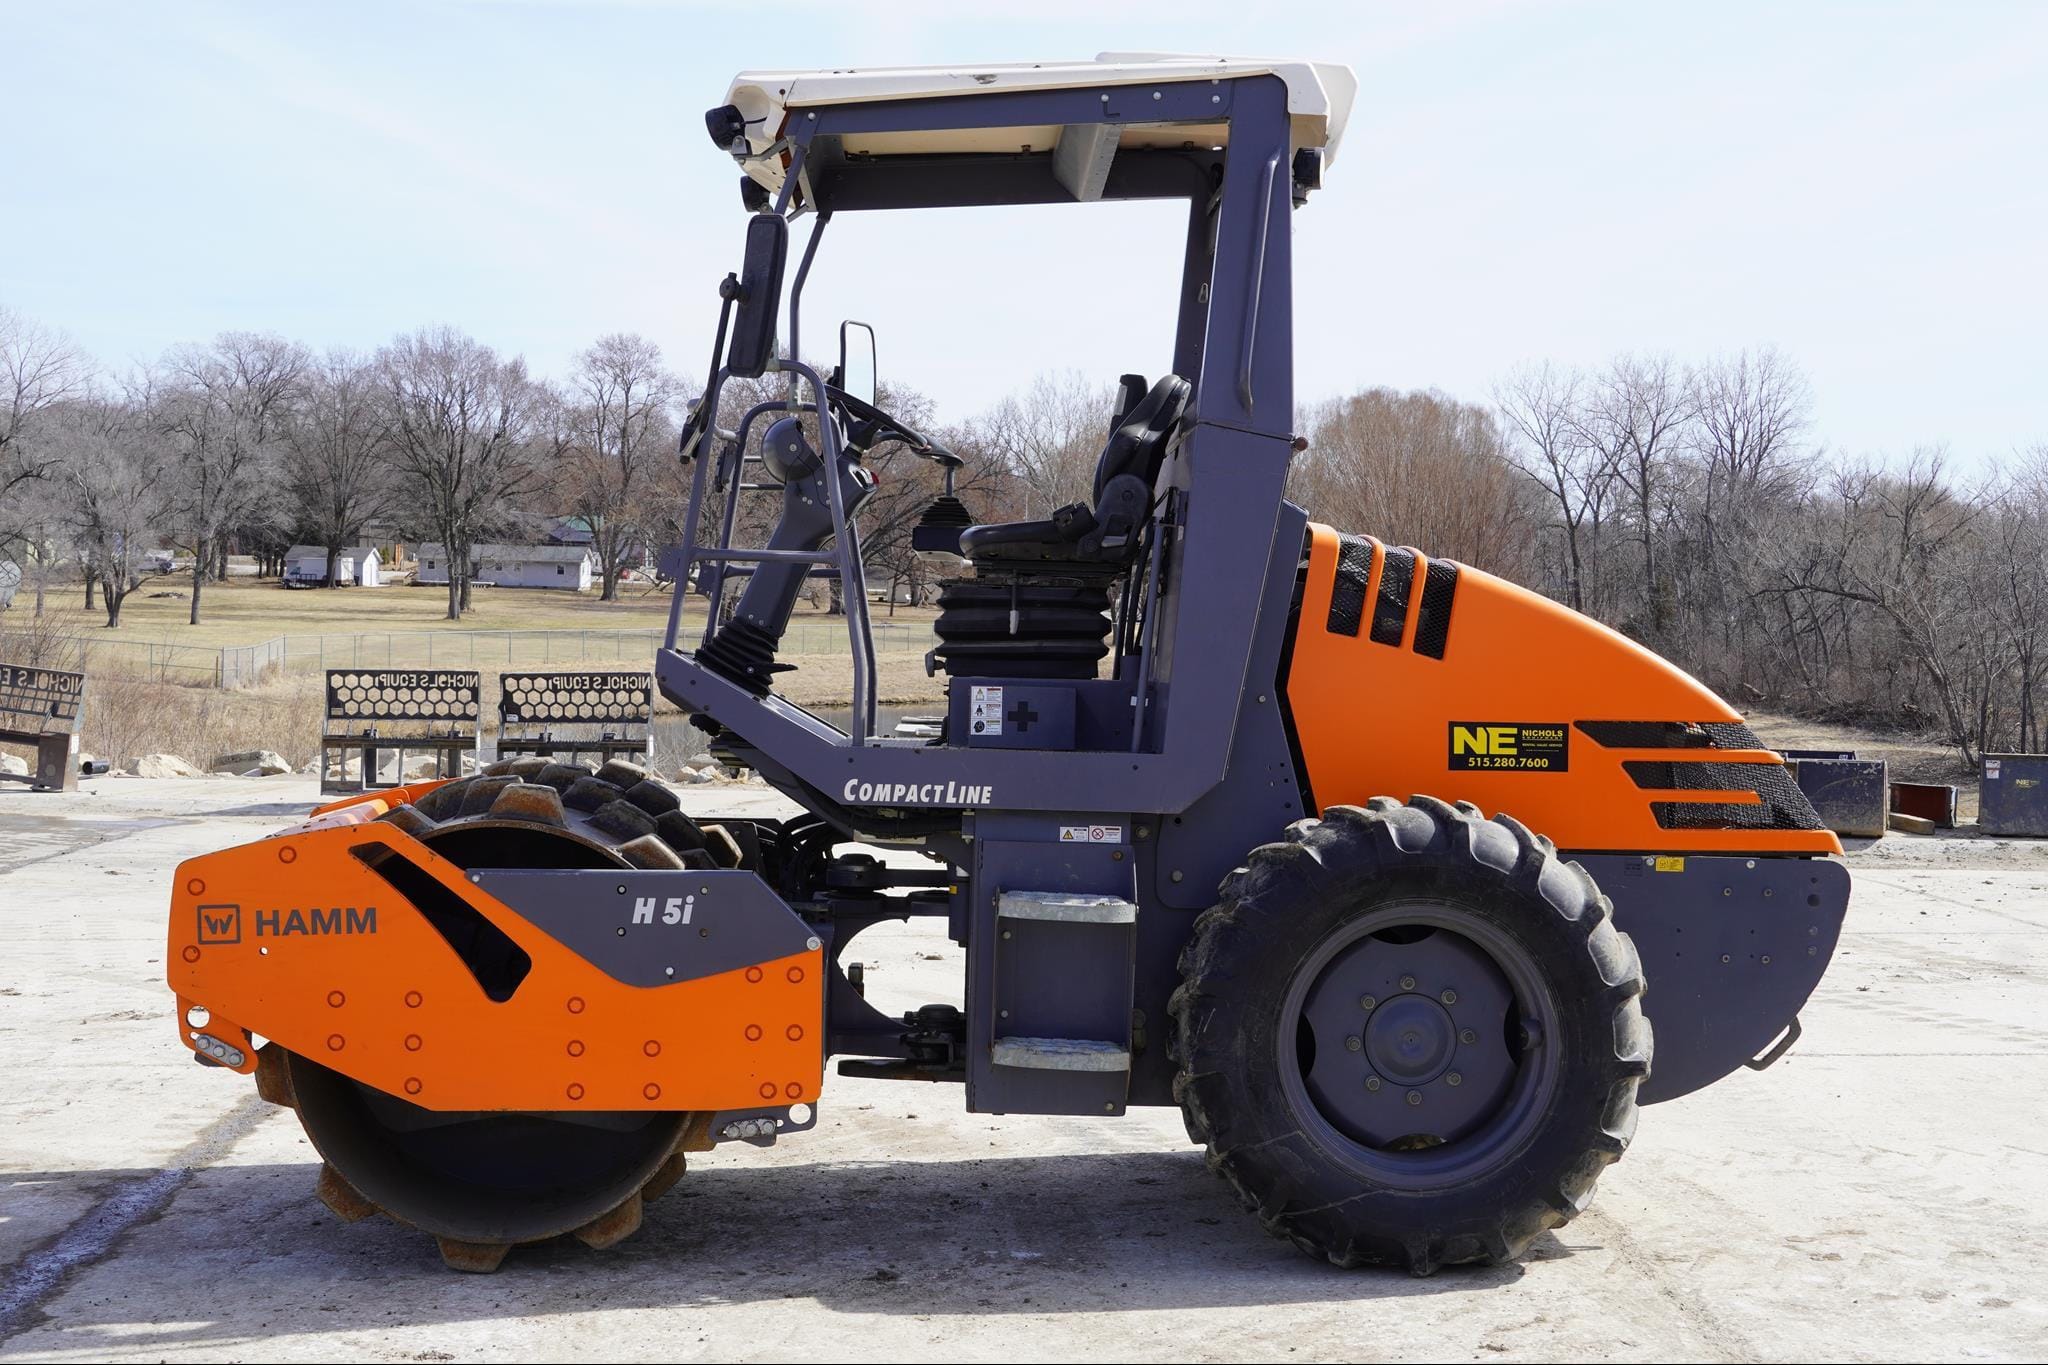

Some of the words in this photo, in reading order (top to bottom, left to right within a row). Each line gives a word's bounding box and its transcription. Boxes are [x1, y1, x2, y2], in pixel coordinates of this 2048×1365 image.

[1454, 727, 1517, 754] NE
[1468, 757, 1549, 768] 515.280.7600
[256, 907, 377, 936] HAMM
[632, 897, 656, 924] H
[662, 895, 695, 925] 5i
